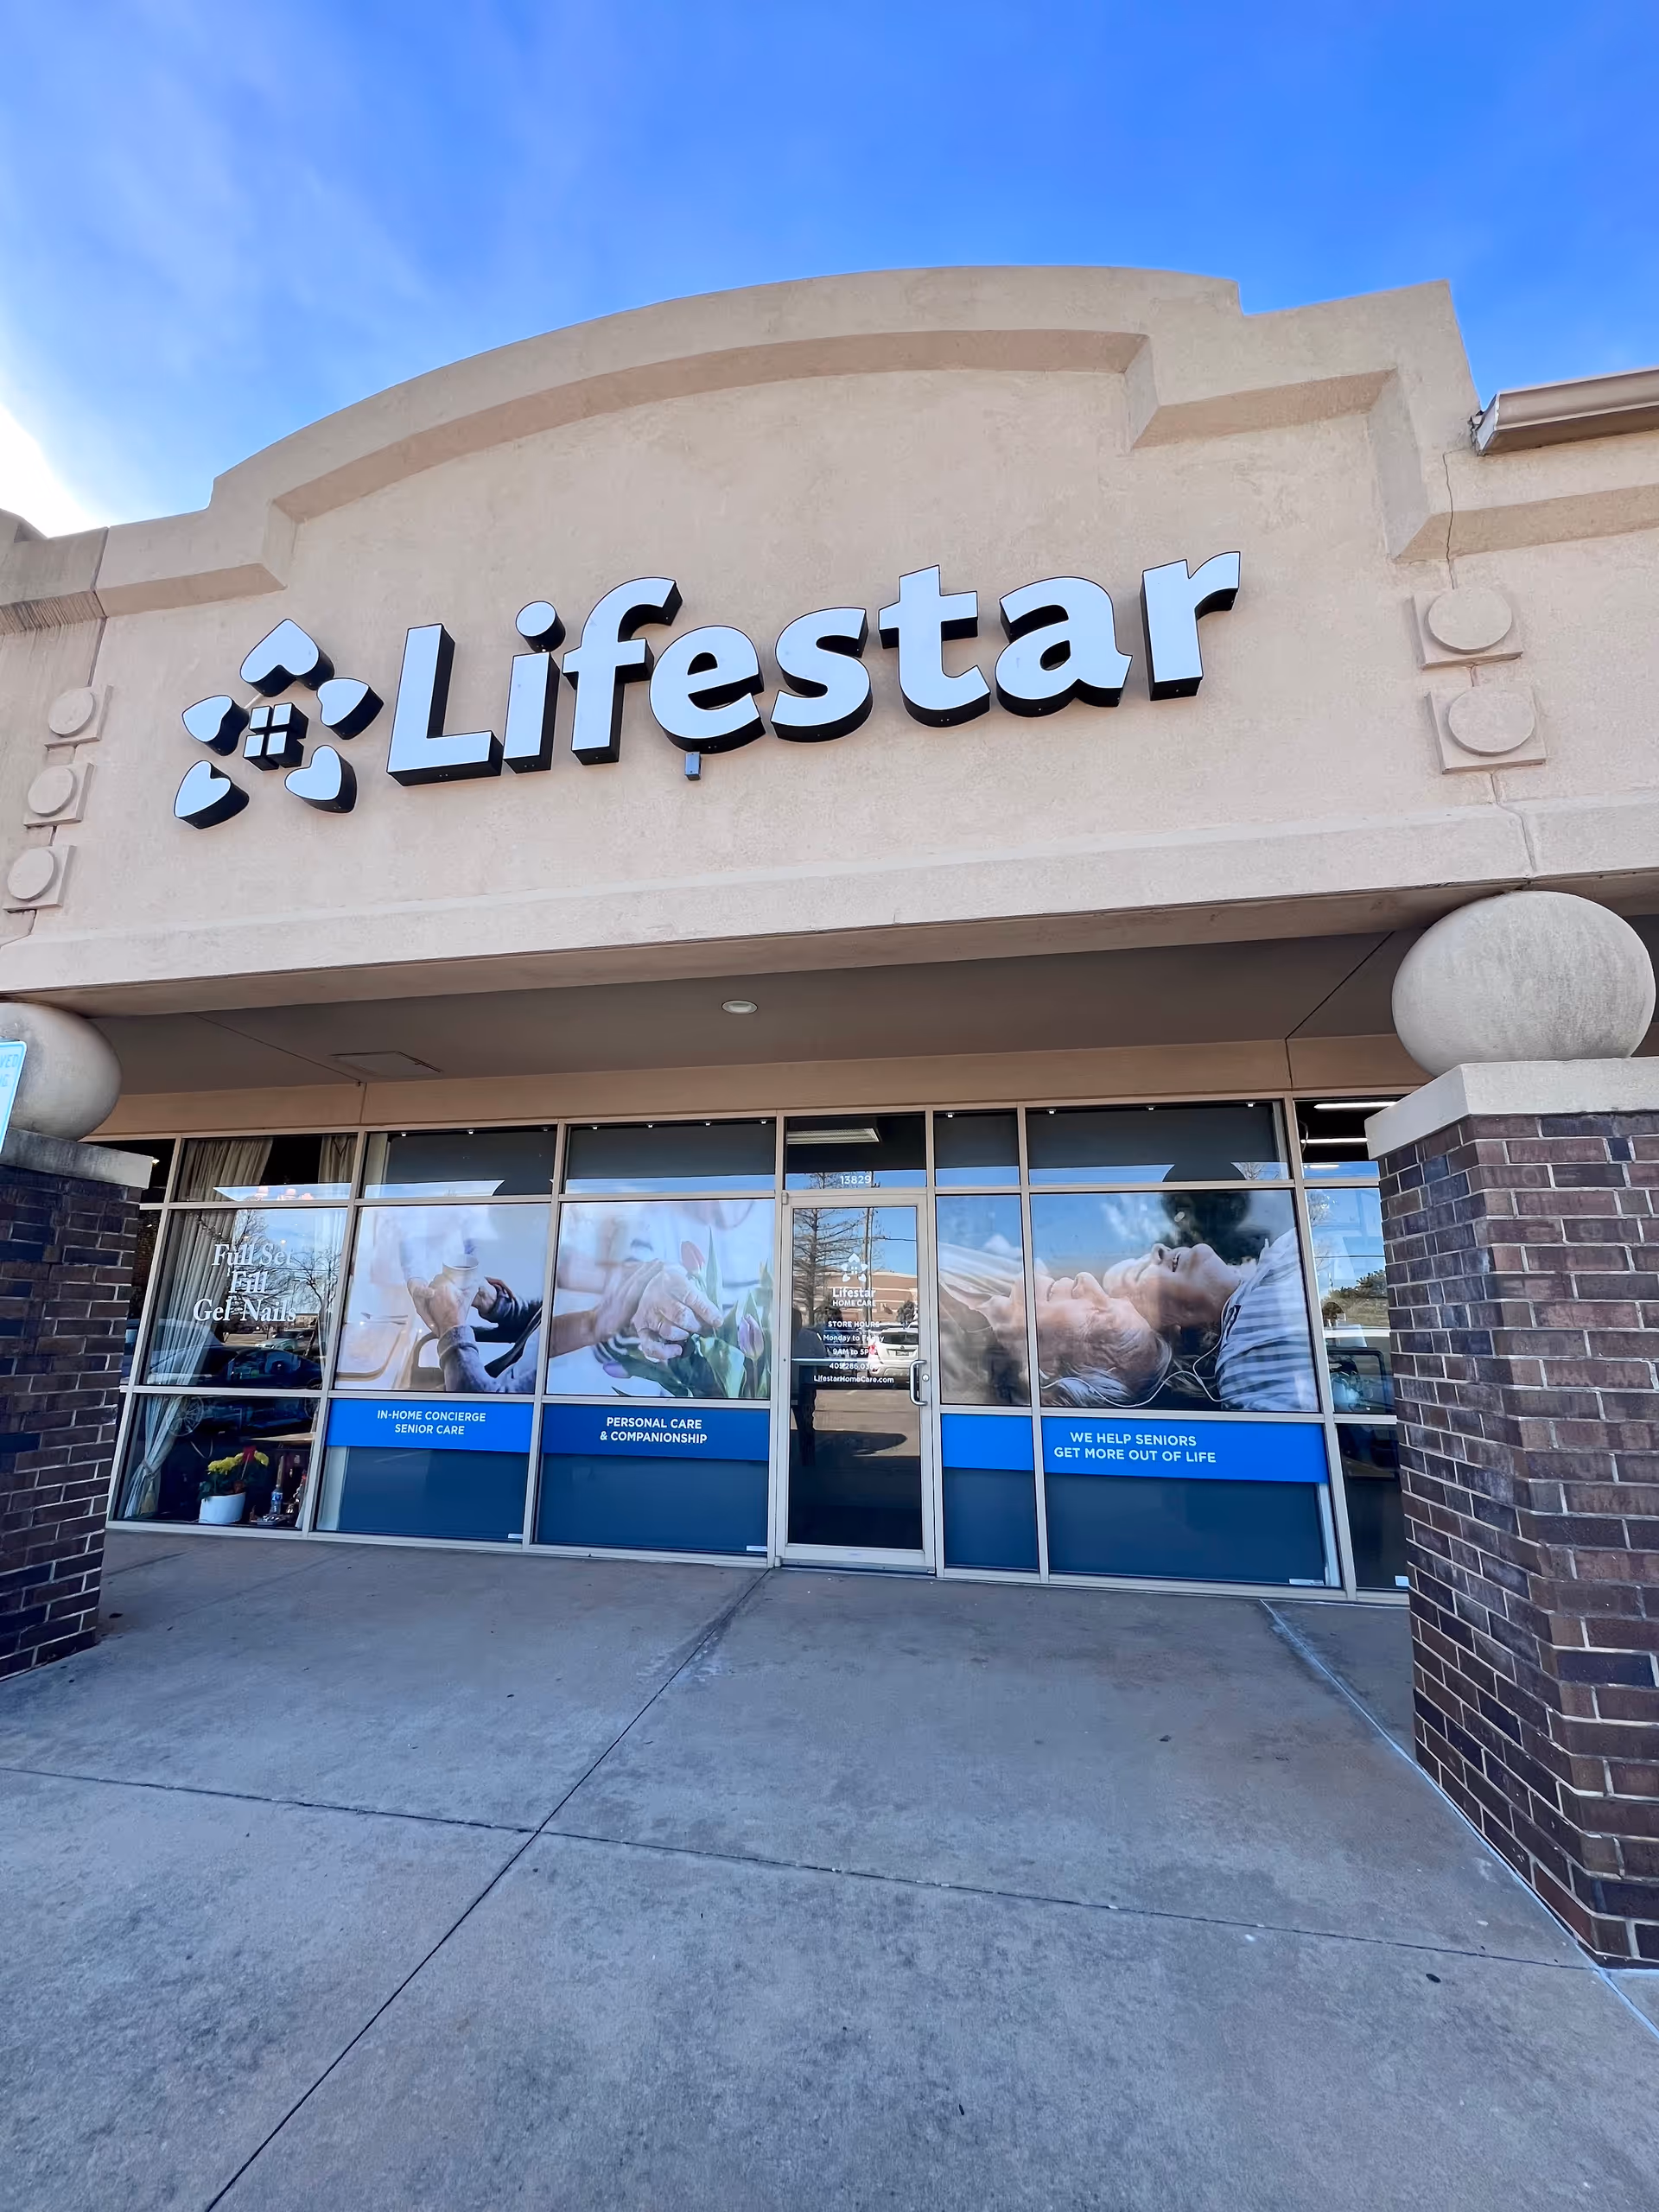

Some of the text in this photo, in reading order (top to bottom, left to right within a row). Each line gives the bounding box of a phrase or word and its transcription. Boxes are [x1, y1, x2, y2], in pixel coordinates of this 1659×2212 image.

[386, 550, 1242, 786] Lifestar
[840, 1175, 871, 1185] 13829
[212, 1243, 292, 1266] Full Set
[228, 1270, 269, 1294] Fill
[832, 1287, 876, 1298] Lifestar
[193, 1296, 296, 1322] Gel Nails
[823, 1334, 851, 1342] Monday
[814, 1375, 894, 1383] LifestarHomeCare.com
[377, 1410, 486, 1422] IN-HOME CONCIERGE
[395, 1424, 465, 1435] SENIOR CARE
[607, 1417, 702, 1430] PERSONAL CARE
[600, 1431, 708, 1444] & COMPANIONSHIP
[1070, 1432, 1197, 1446] WE HELP SENIORS
[1054, 1447, 1217, 1463] GET MORE OUT OF LIFE
